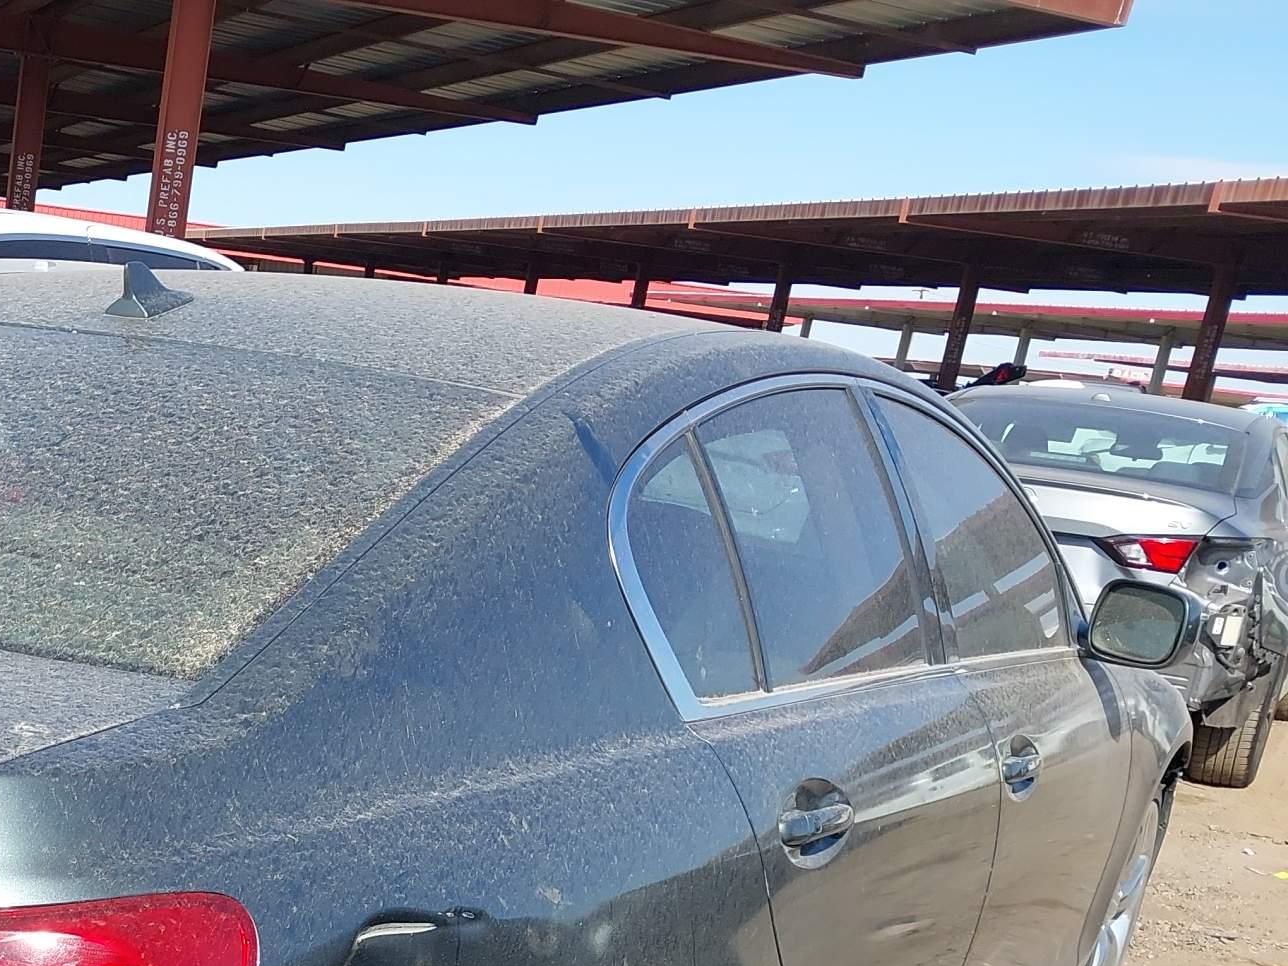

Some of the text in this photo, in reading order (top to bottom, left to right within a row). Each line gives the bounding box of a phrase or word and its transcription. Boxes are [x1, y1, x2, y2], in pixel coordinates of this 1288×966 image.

[165, 129, 179, 153] INC.
[16, 152, 26, 170] INC.
[158, 159, 174, 208] PREFAB
